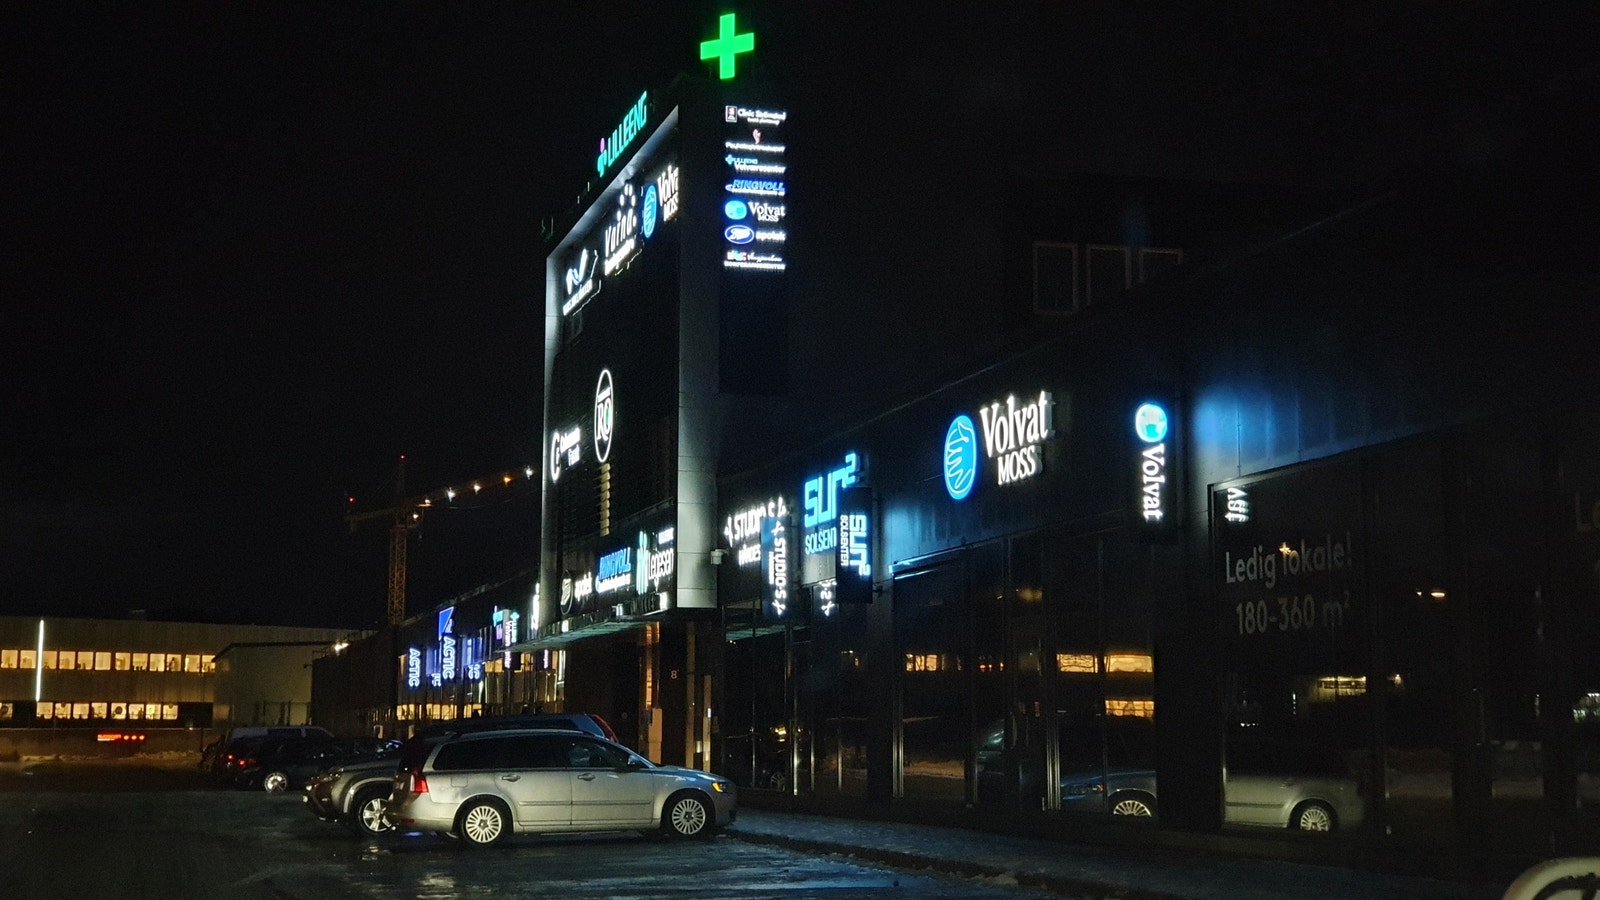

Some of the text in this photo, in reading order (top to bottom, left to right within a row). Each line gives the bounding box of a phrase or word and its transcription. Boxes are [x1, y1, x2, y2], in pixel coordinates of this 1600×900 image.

[608, 91, 647, 167] LILLEENG
[733, 180, 785, 191] RINGVOLL
[748, 202, 785, 216] Volvat
[758, 213, 778, 222] MOSS
[980, 390, 1048, 458] Volvat
[998, 445, 1036, 485] MOSS
[1142, 443, 1165, 521] Volvat
[840, 515, 849, 567] SOLSENTER
[599, 547, 631, 580] RINGVOLL
[1226, 545, 1276, 589] Ledig
[1236, 594, 1316, 635] 180-360
[408, 648, 421, 688] ACTIC
[442, 636, 456, 680] ACTIC
[670, 669, 678, 680] 8
